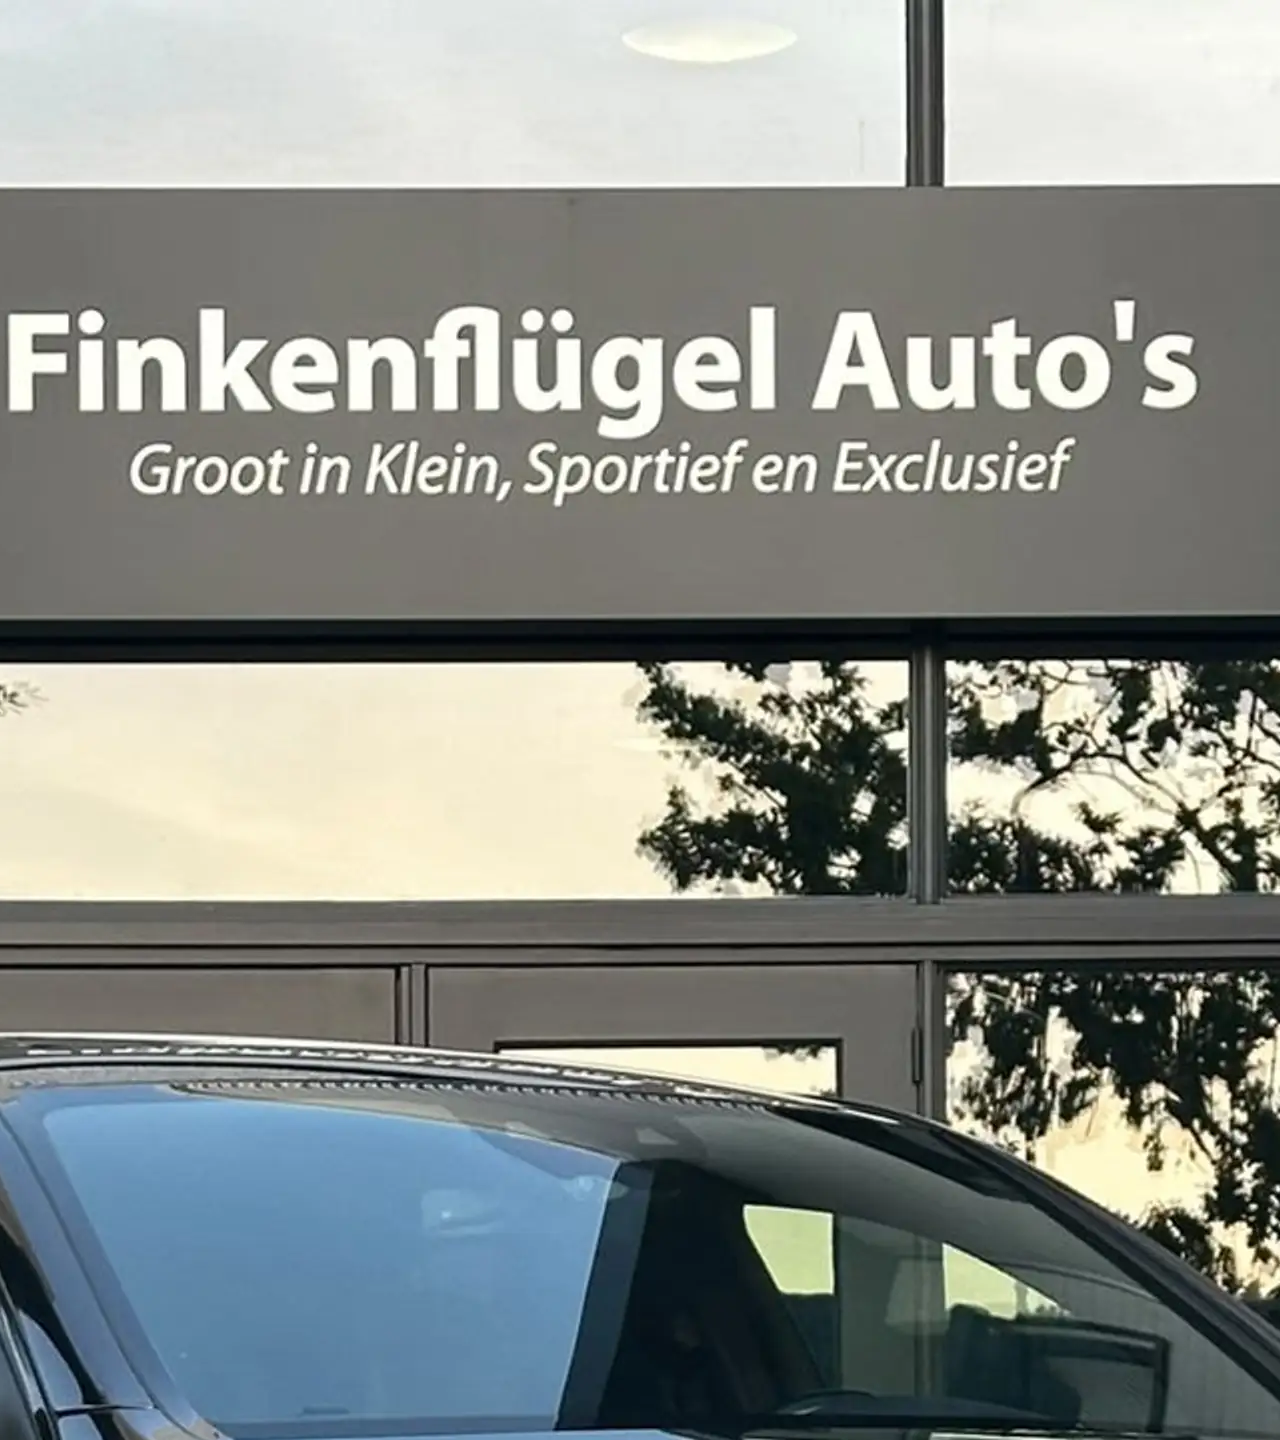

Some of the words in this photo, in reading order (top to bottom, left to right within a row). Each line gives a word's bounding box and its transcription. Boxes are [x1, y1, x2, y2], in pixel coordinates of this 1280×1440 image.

[7, 305, 777, 441] Finkenflügel
[810, 299, 1199, 412] Auto's
[129, 442, 290, 495] Groot
[299, 442, 351, 494] in
[364, 440, 512, 502] Klein,
[523, 438, 749, 507] Sportief
[752, 452, 818, 494] en
[832, 437, 1076, 493] Exclusief
